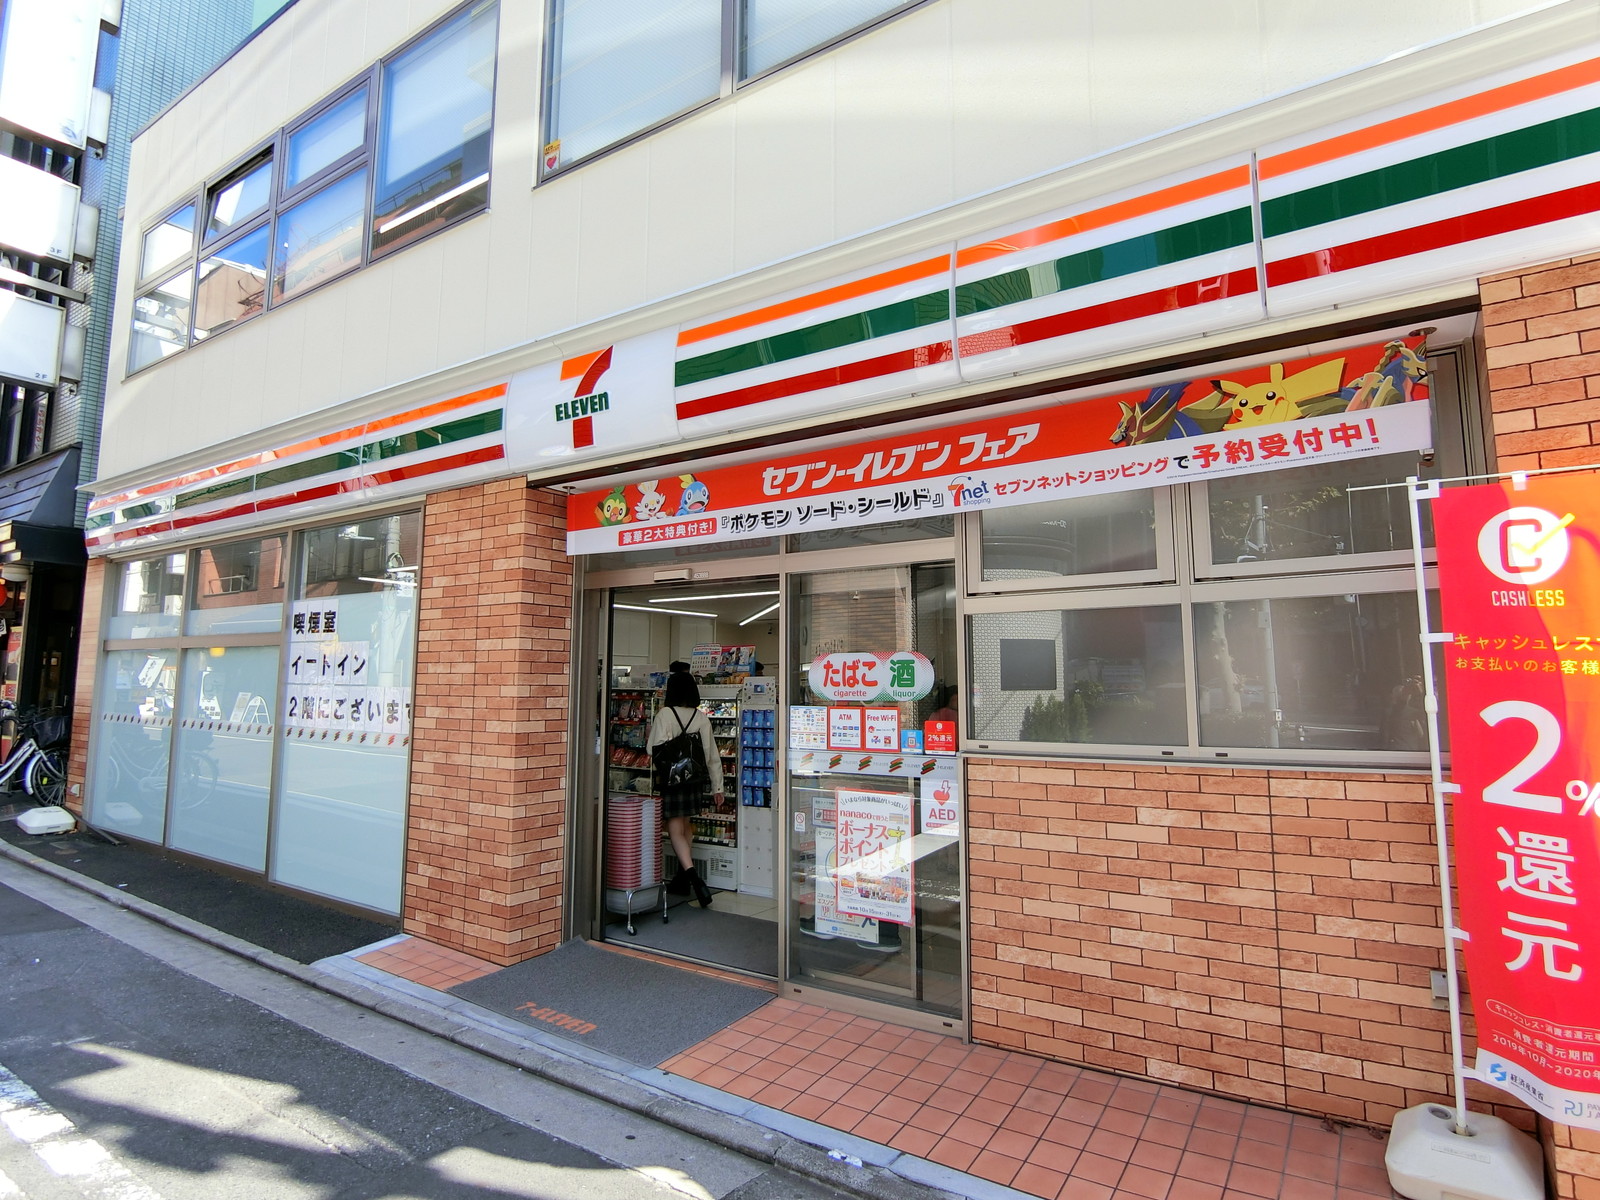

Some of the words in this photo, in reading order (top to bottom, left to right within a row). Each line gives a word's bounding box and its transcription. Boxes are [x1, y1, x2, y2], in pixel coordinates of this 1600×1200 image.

[958, 423, 1041, 466] フェア
[963, 496, 991, 507] shopping
[1491, 589, 1565, 607] CASHLESS
[293, 609, 337, 635] 喫煙室
[1454, 632, 1600, 652] キャッシュレス
[291, 653, 366, 676] イートイン
[823, 658, 878, 689] たばこ
[889, 659, 916, 688] 酒
[833, 689, 867, 698] cigarette
[892, 689, 916, 698] liquor
[838, 713, 852, 721] ATM
[866, 714, 880, 722] Free
[880, 714, 897, 722] Wi-Fi
[928, 807, 956, 821] AED
[839, 820, 889, 840] ボーナス
[839, 838, 889, 857] ポイント
[1495, 826, 1583, 982] 還元
[1513, 1028, 1594, 1063] 消費者還元期間
[1510, 1073, 1544, 1101] 経済産業省
